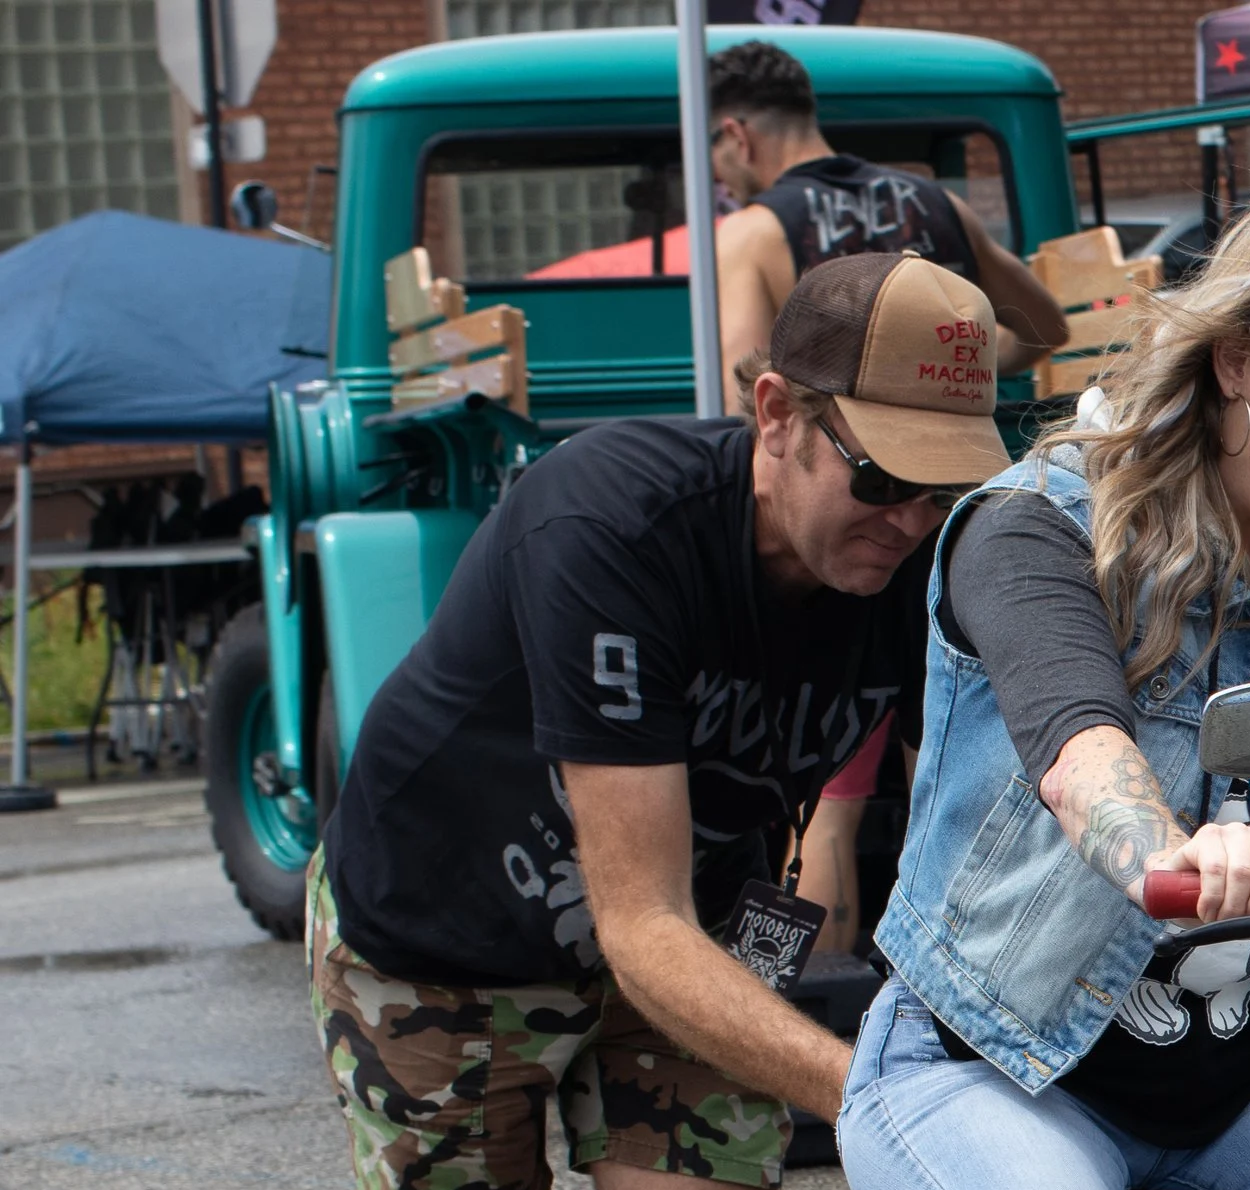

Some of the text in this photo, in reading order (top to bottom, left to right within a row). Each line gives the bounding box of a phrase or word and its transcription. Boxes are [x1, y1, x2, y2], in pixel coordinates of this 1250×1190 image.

[804, 176, 929, 254] SLAYER
[935, 319, 989, 346] DEUS
[954, 345, 979, 363] EX
[917, 361, 994, 385] MACHINA
[592, 632, 643, 721] 9
[737, 909, 811, 957] MOTOBLOT
